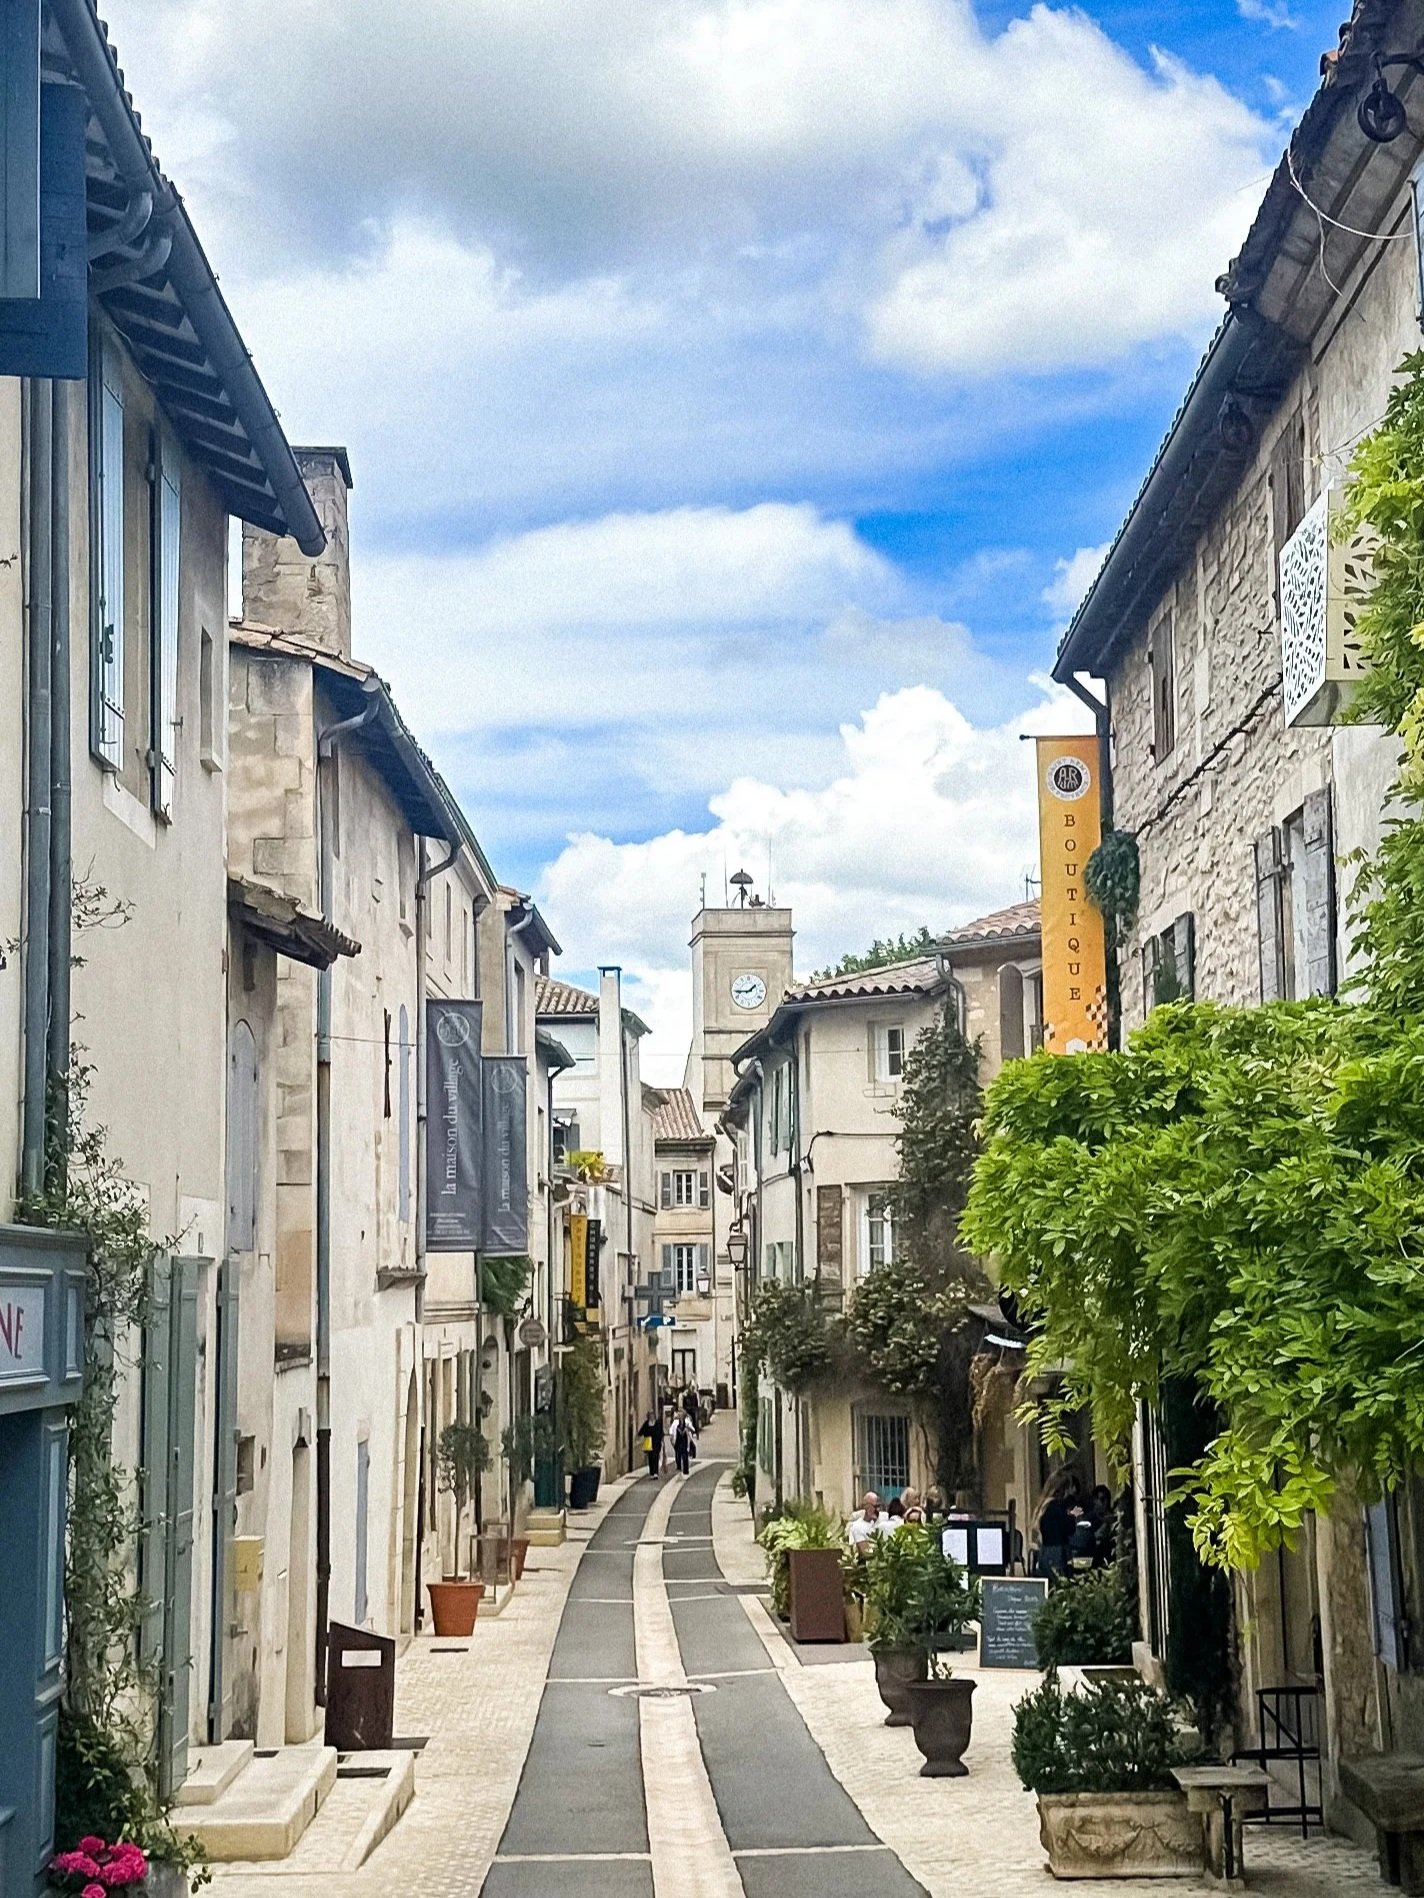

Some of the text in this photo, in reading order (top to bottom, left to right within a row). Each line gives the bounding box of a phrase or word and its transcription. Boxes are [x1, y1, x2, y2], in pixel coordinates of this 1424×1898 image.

[1064, 814, 1081, 1001] BOUTIQUE
[441, 1058, 464, 1196] la maison du village
[497, 1140, 510, 1156] du
[499, 1159, 511, 1201] mson
